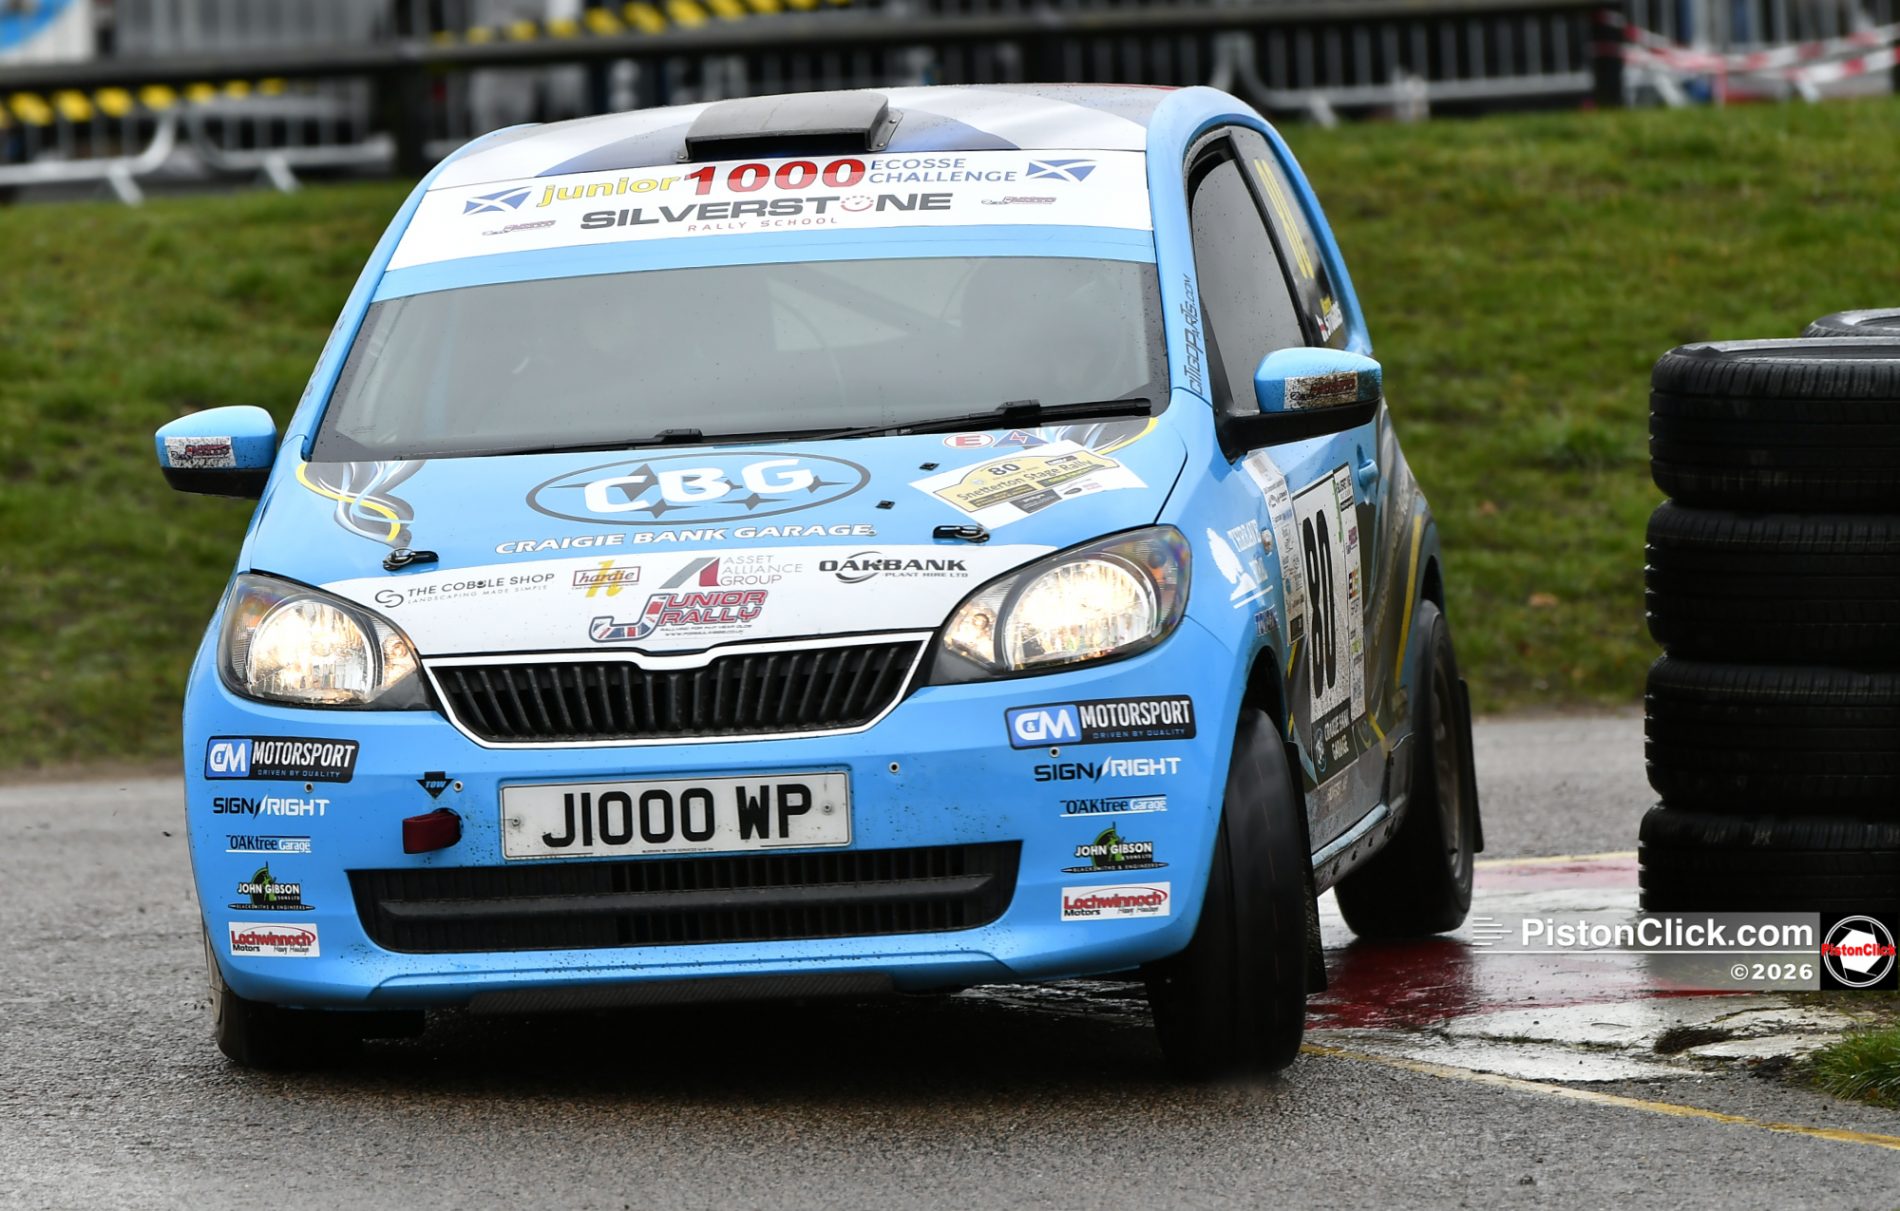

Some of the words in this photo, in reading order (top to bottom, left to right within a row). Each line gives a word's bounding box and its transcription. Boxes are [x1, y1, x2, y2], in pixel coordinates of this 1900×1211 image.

[871, 158, 967, 171] ECOSSE
[536, 176, 683, 208] junior
[684, 158, 866, 196] 1000
[869, 170, 1017, 184] CHALLENGE
[687, 220, 748, 233] RALLY
[760, 217, 838, 229] SCHOOL
[987, 463, 1021, 476] 80
[583, 458, 816, 513] CBG
[956, 476, 1026, 502] Snetterton
[1023, 466, 1061, 484] Stage
[1059, 459, 1094, 472] Rally
[494, 532, 625, 555] CRAIGIE
[632, 527, 731, 545] BANK
[733, 525, 876, 540] GARAGE
[723, 554, 773, 565] ASSET
[819, 559, 968, 572] OAKBANK
[722, 562, 803, 574] ALLIANCE
[579, 567, 636, 586] hardie
[720, 574, 783, 587] GROUP
[407, 585, 437, 598] THE
[508, 573, 556, 586] SHOP
[407, 592, 478, 605] LANDSCAPING
[482, 588, 509, 596] MADE
[514, 584, 548, 593] SIMPLE
[1302, 508, 1337, 700] 80
[657, 605, 763, 627] RALLY
[1079, 700, 1191, 730] MOTORSPORT
[1093, 731, 1129, 739] DRIVEN
[1146, 728, 1185, 737] QUALITY
[252, 741, 356, 768] MOTORSPORT
[257, 769, 287, 777] DRIVEN
[289, 769, 300, 777] BY
[302, 770, 341, 778] QUALITY
[425, 780, 447, 789] TOW
[1129, 798, 1167, 812] Garage
[541, 787, 716, 848] J1000
[736, 783, 813, 841] WP
[278, 838, 311, 852] Garage
[1074, 846, 1108, 857] JOHN
[1110, 842, 1153, 855] GIBSON
[237, 883, 262, 894] JOHN
[265, 884, 300, 895] GIBSON
[1063, 892, 1162, 910] Lochwinnoch
[1064, 909, 1101, 917] Motors
[231, 931, 312, 947] Lochwinnoch
